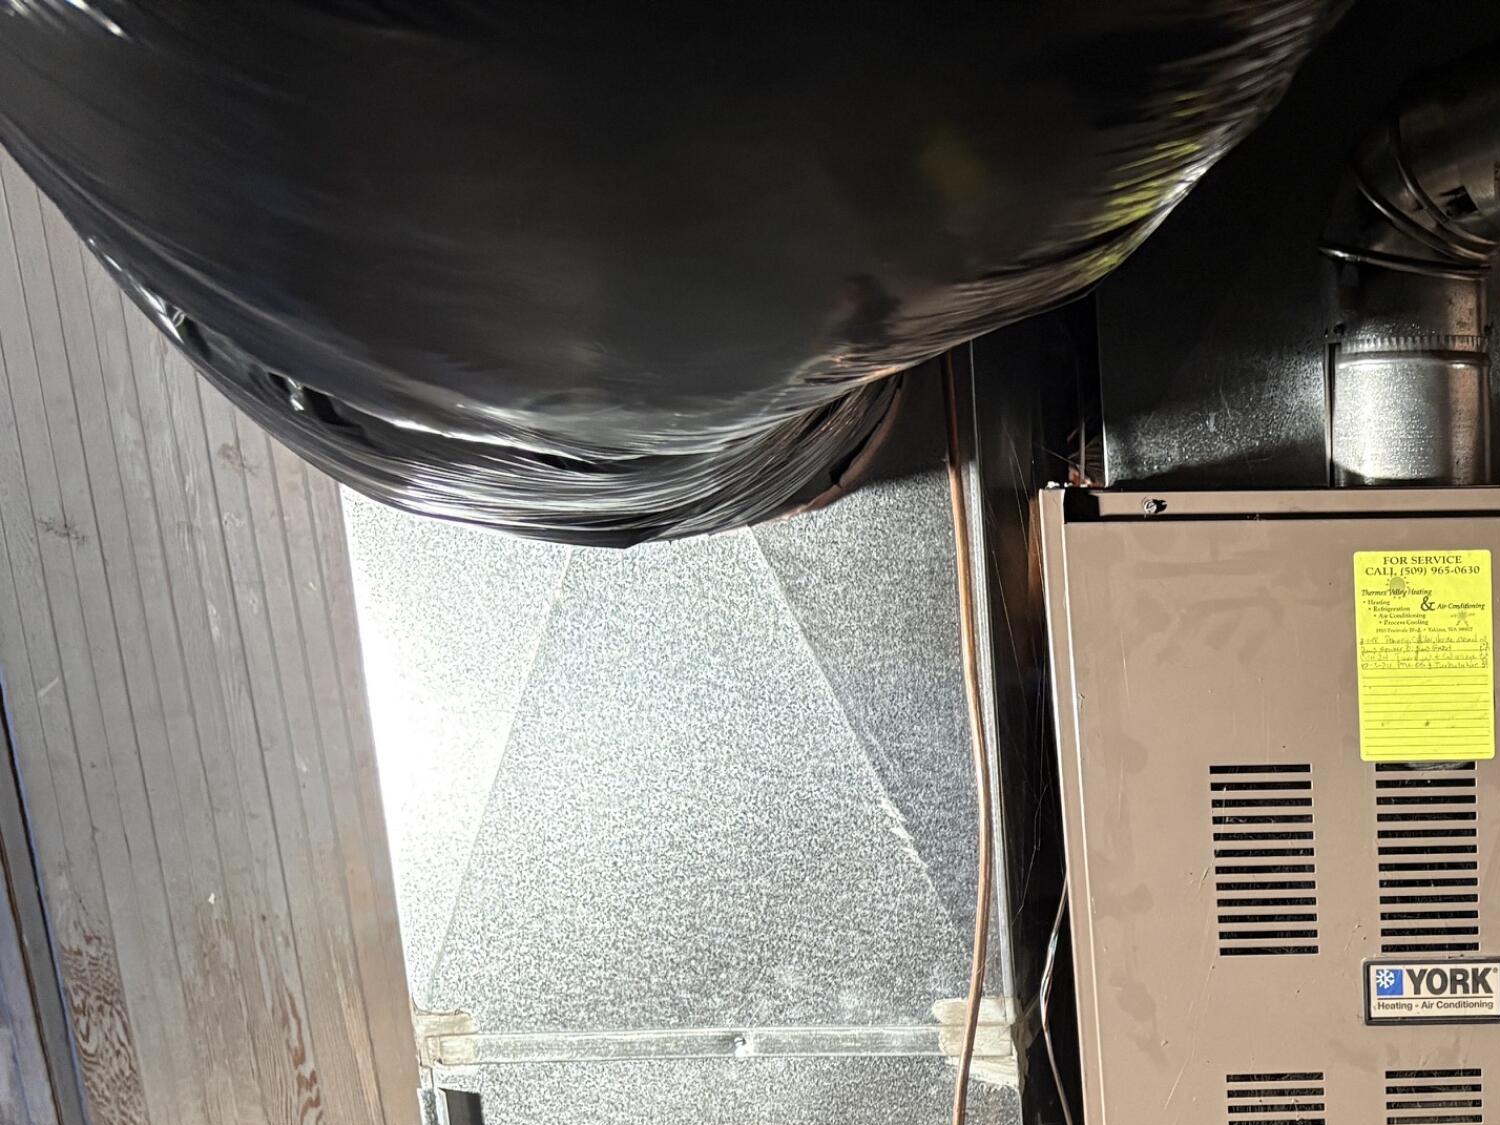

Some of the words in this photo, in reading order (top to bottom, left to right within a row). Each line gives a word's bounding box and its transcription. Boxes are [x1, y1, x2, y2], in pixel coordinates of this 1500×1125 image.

[1383, 556, 1408, 565] FOR
[1411, 555, 1462, 565] SERVICE
[1400, 566, 1427, 576] (509)
[1431, 565, 1480, 575] 965-0630
[1420, 595, 1435, 611] &
[1448, 602, 1486, 610] Conditioning
[1377, 1001, 1413, 1011] Heating
[1421, 1001, 1434, 1009] Air
[1436, 1000, 1494, 1010] Conditioning
